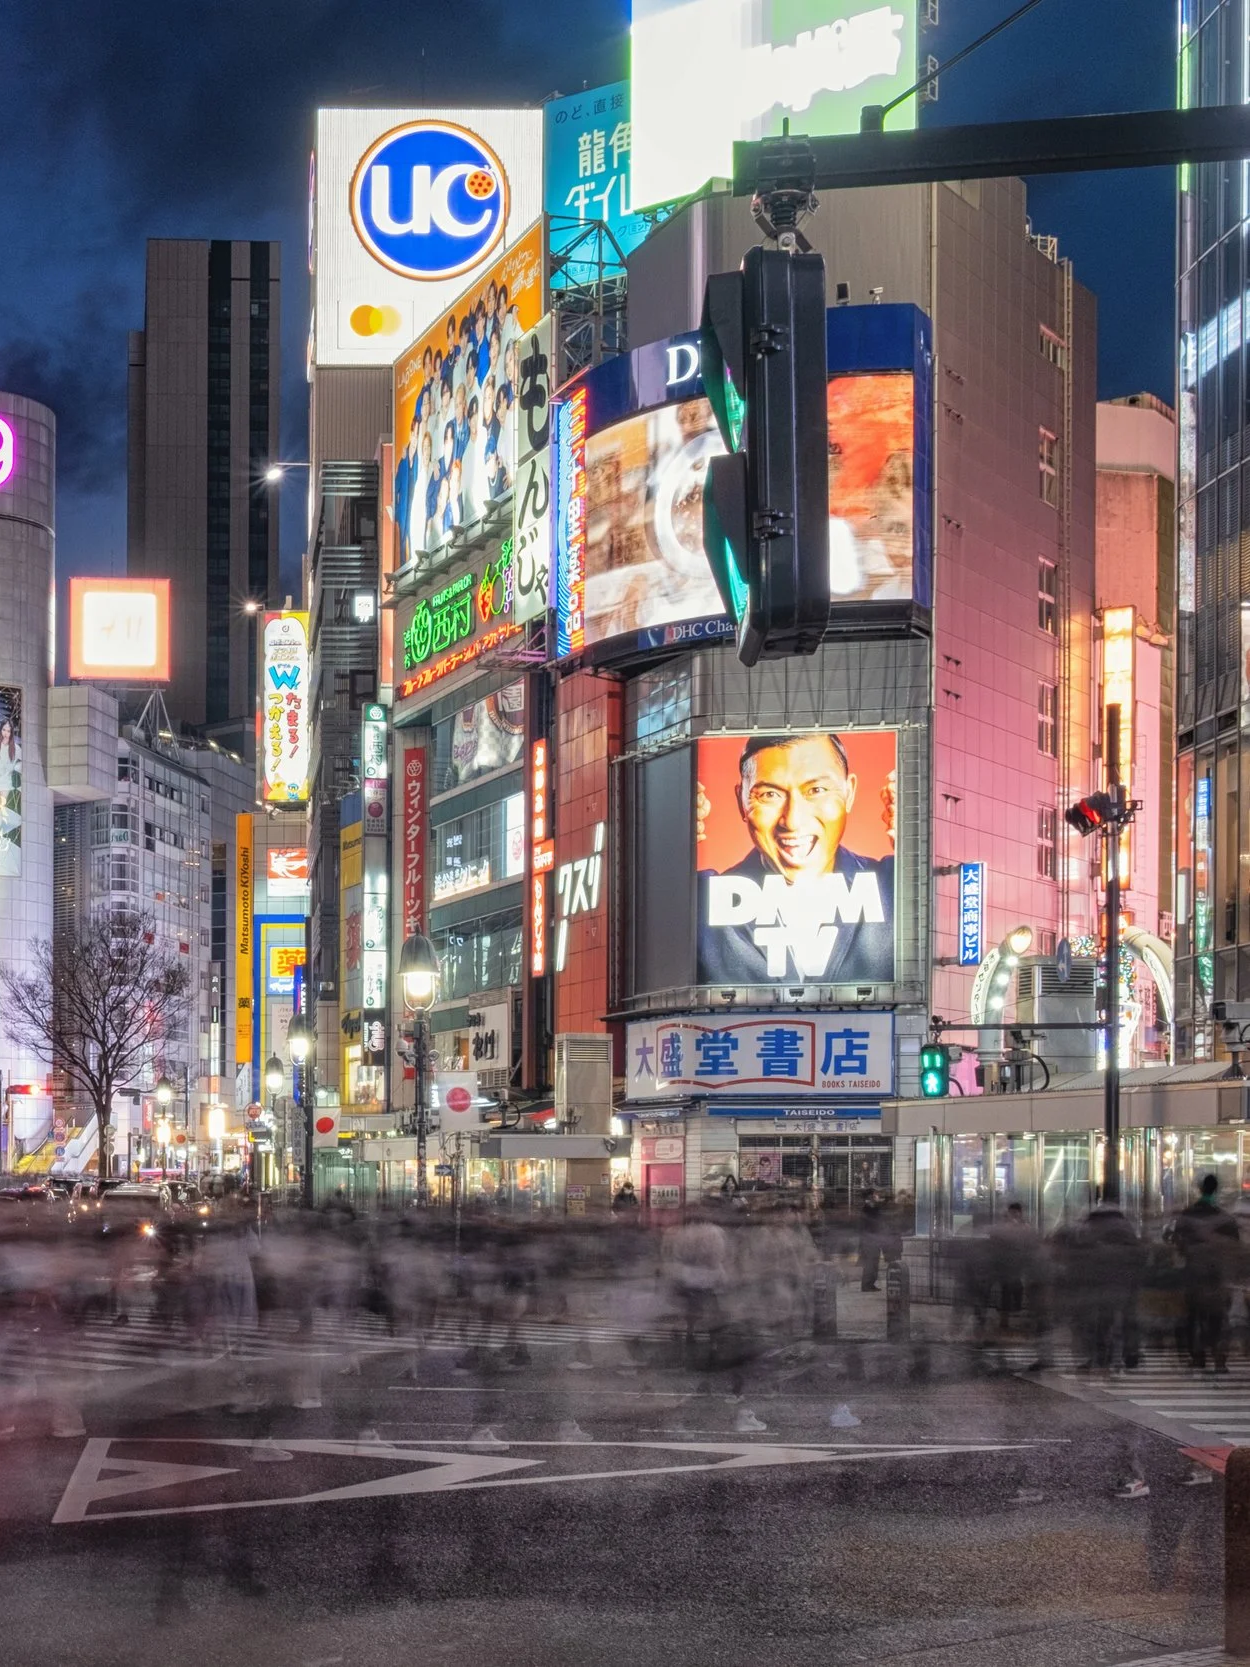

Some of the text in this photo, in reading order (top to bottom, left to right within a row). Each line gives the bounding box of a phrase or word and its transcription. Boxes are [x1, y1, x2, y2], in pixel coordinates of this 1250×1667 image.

[371, 163, 496, 238] UC
[673, 619, 735, 641] DHC Cha
[239, 888, 250, 955] Matsumoto
[708, 872, 885, 926] DMM
[963, 869, 979, 961] 大盛堂商事ビル
[753, 926, 839, 978] TV
[635, 1028, 871, 1082] 大盛堂書店
[822, 1080, 881, 1088] BOOKS TAISEIDO
[783, 1109, 835, 1117] TAISEIDO
